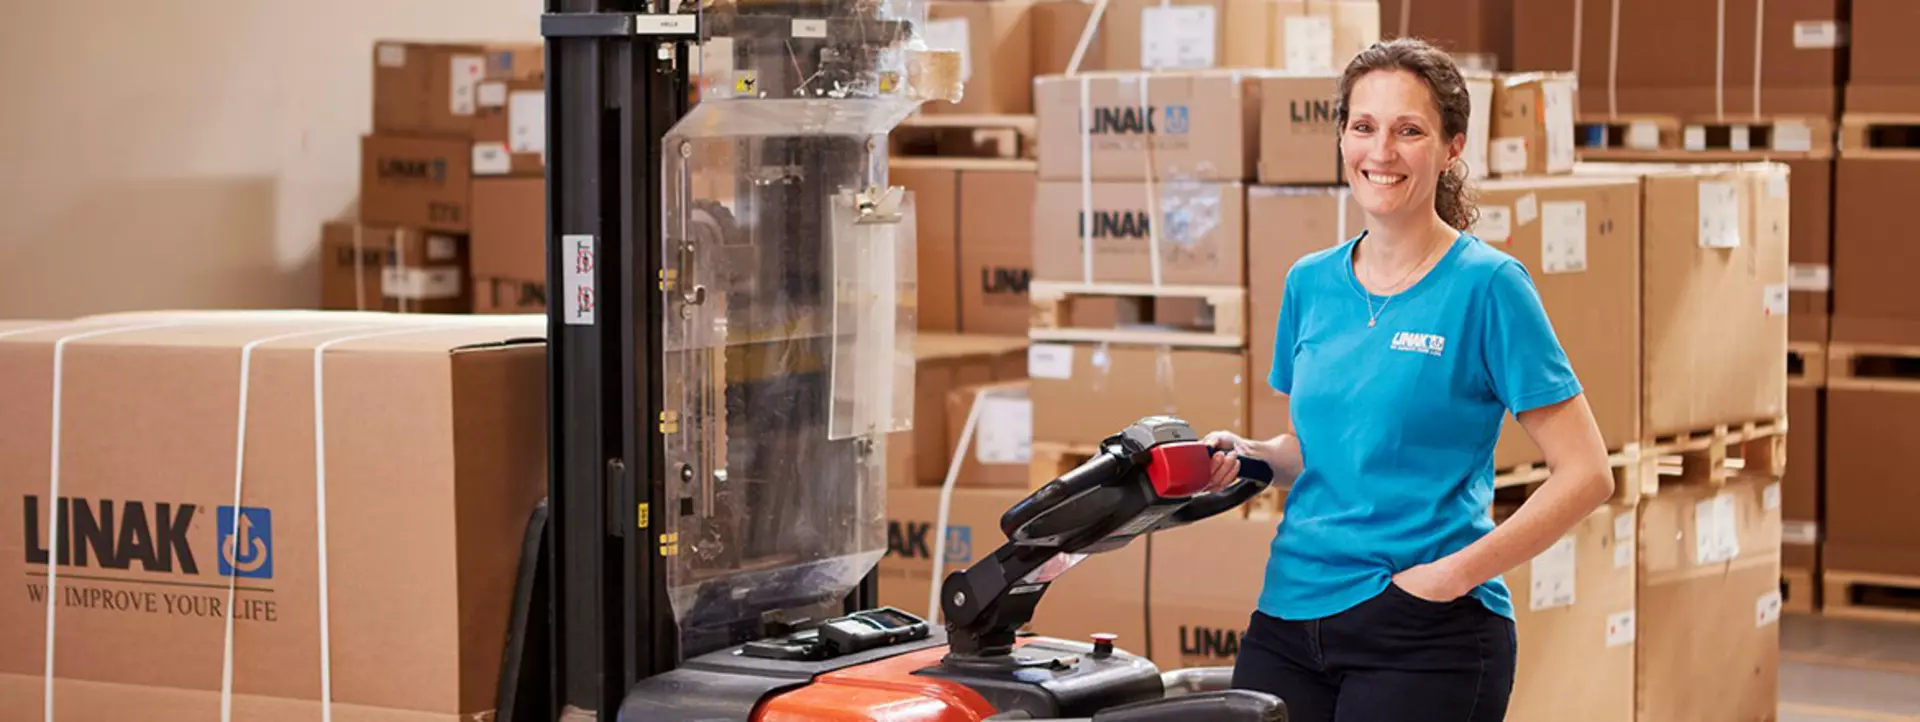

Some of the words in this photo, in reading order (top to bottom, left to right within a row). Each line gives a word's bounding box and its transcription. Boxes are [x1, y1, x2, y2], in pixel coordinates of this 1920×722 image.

[981, 267, 1033, 294] LINA
[1391, 331, 1427, 347] LINAK
[23, 494, 199, 576] LINAK
[64, 585, 158, 613] IMPROVE
[162, 593, 224, 618] YOUR
[1179, 625, 1242, 657] LINA
